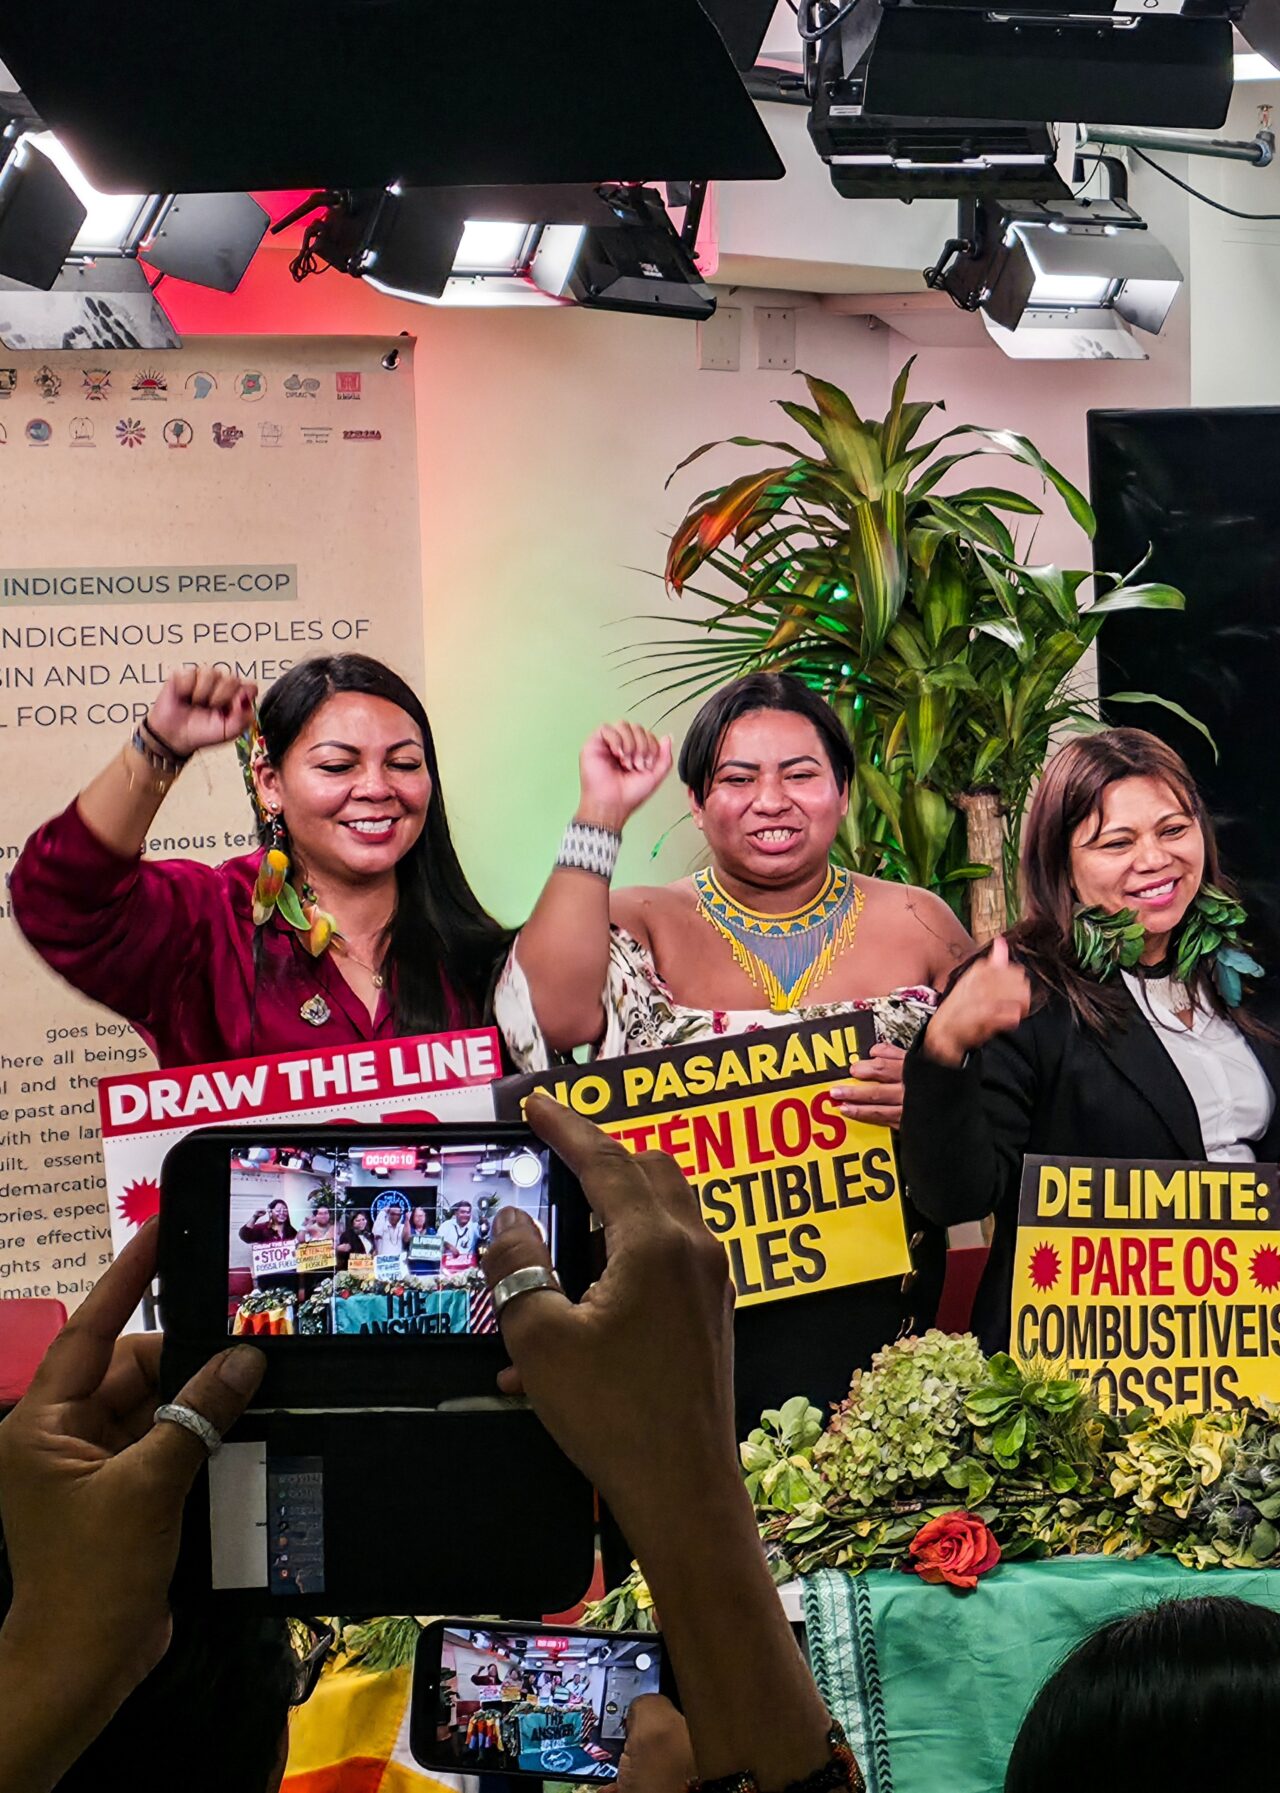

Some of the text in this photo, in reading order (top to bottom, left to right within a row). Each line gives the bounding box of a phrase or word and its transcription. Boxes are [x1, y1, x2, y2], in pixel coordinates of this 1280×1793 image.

[3, 573, 291, 596] INDIGENOUS PRE-COP
[2, 619, 371, 649] NDIGENOUS PEOPLES OF
[44, 665, 111, 687] AND
[119, 662, 169, 685] ALL
[17, 702, 155, 727] FOR COP
[46, 1026, 88, 1043] goes
[53, 1049, 74, 1065] all
[84, 1044, 147, 1063] beings
[623, 1026, 861, 1107] PASARÁN!
[20, 1077, 56, 1094] and
[69, 1075, 99, 1090] the
[107, 1035, 495, 1126] DRAW THE LINE
[14, 1104, 54, 1123] past
[60, 1099, 95, 1116] and
[40, 1127, 70, 1143] the
[741, 1090, 848, 1165] LOS
[365, 1154, 414, 1166] 00:00:10
[1037, 1165, 1271, 1222] DE LIMITE:
[51, 1252, 86, 1270] and
[261, 1248, 290, 1264] STOP
[1070, 1236, 1239, 1296] PARE OS
